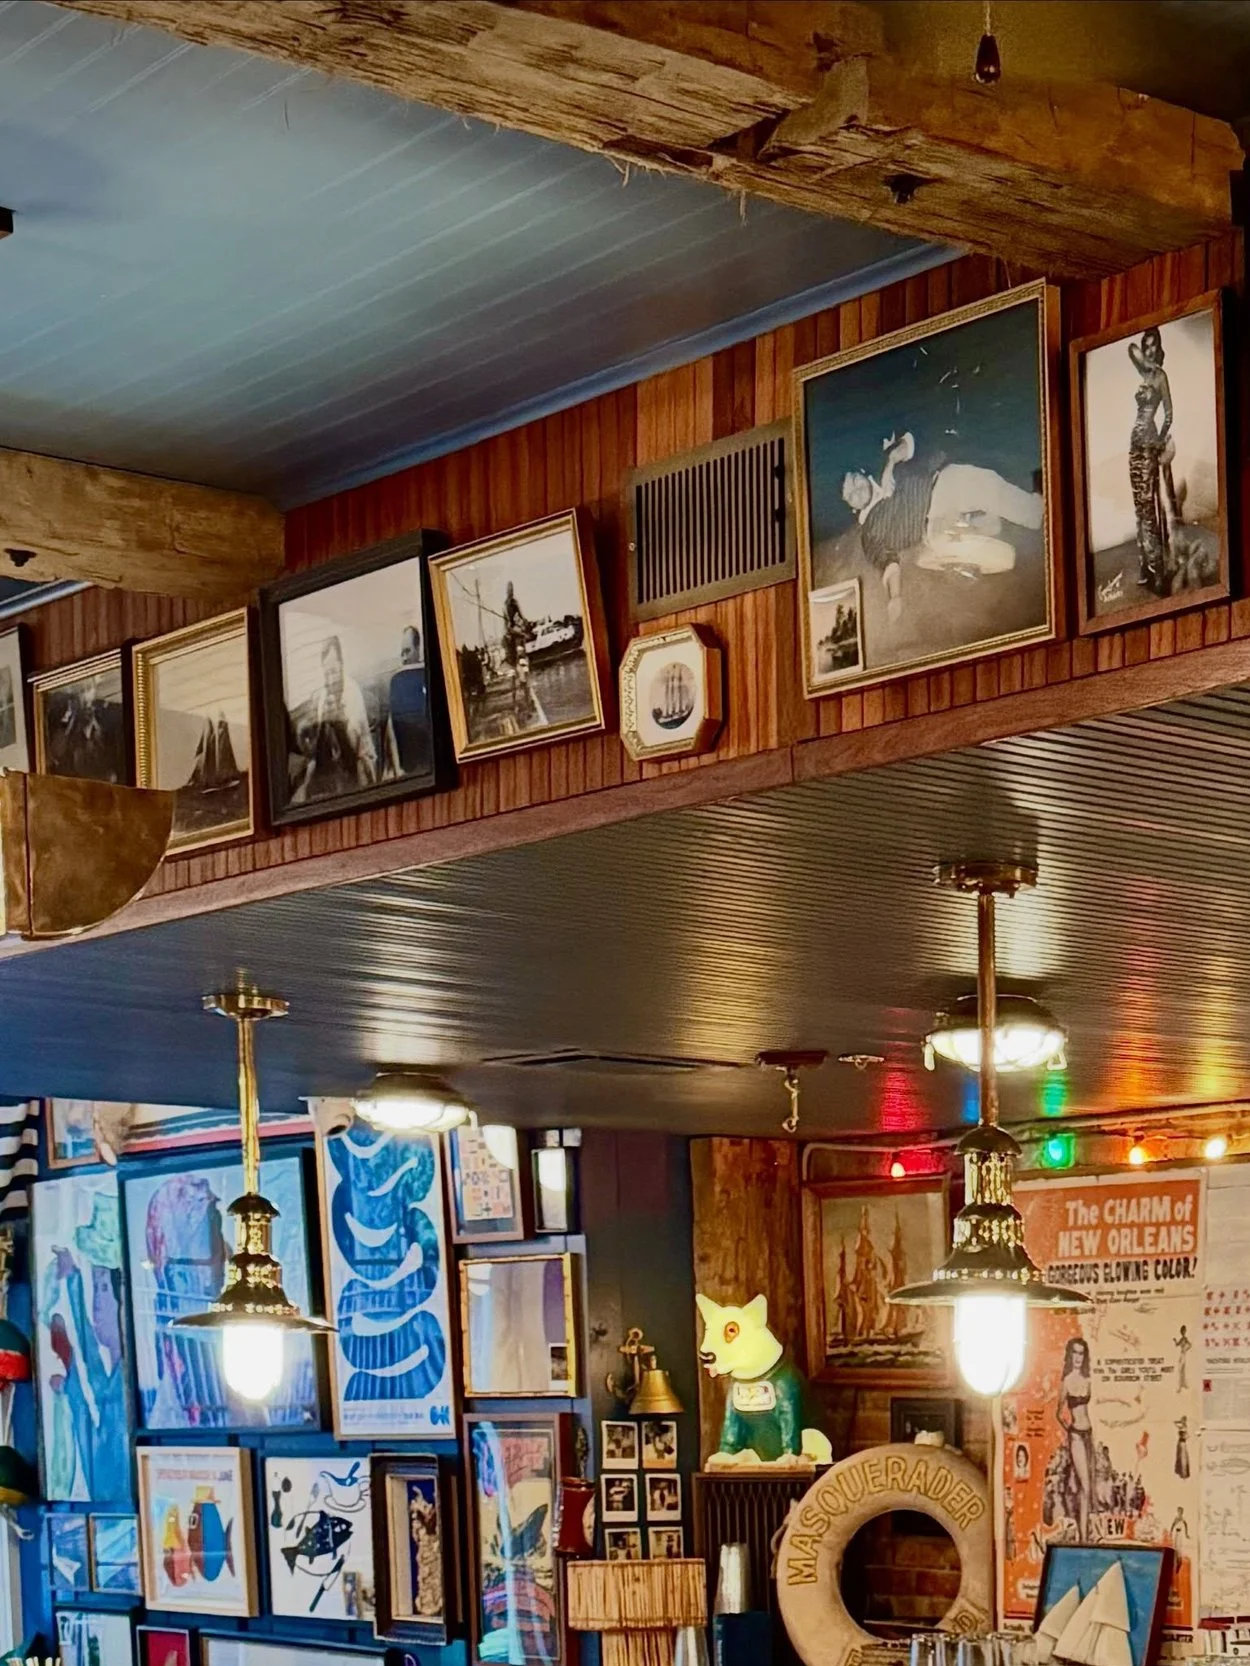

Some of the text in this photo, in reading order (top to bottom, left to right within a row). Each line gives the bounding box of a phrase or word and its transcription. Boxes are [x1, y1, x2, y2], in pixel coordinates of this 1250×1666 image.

[1065, 1194, 1194, 1227] The CHARM of
[1058, 1225, 1195, 1258] NEW ORLEANS
[1048, 1256, 1198, 1286] GORGEOUS GLOWING COLOR!
[787, 1456, 985, 1586] MASQUERADER
